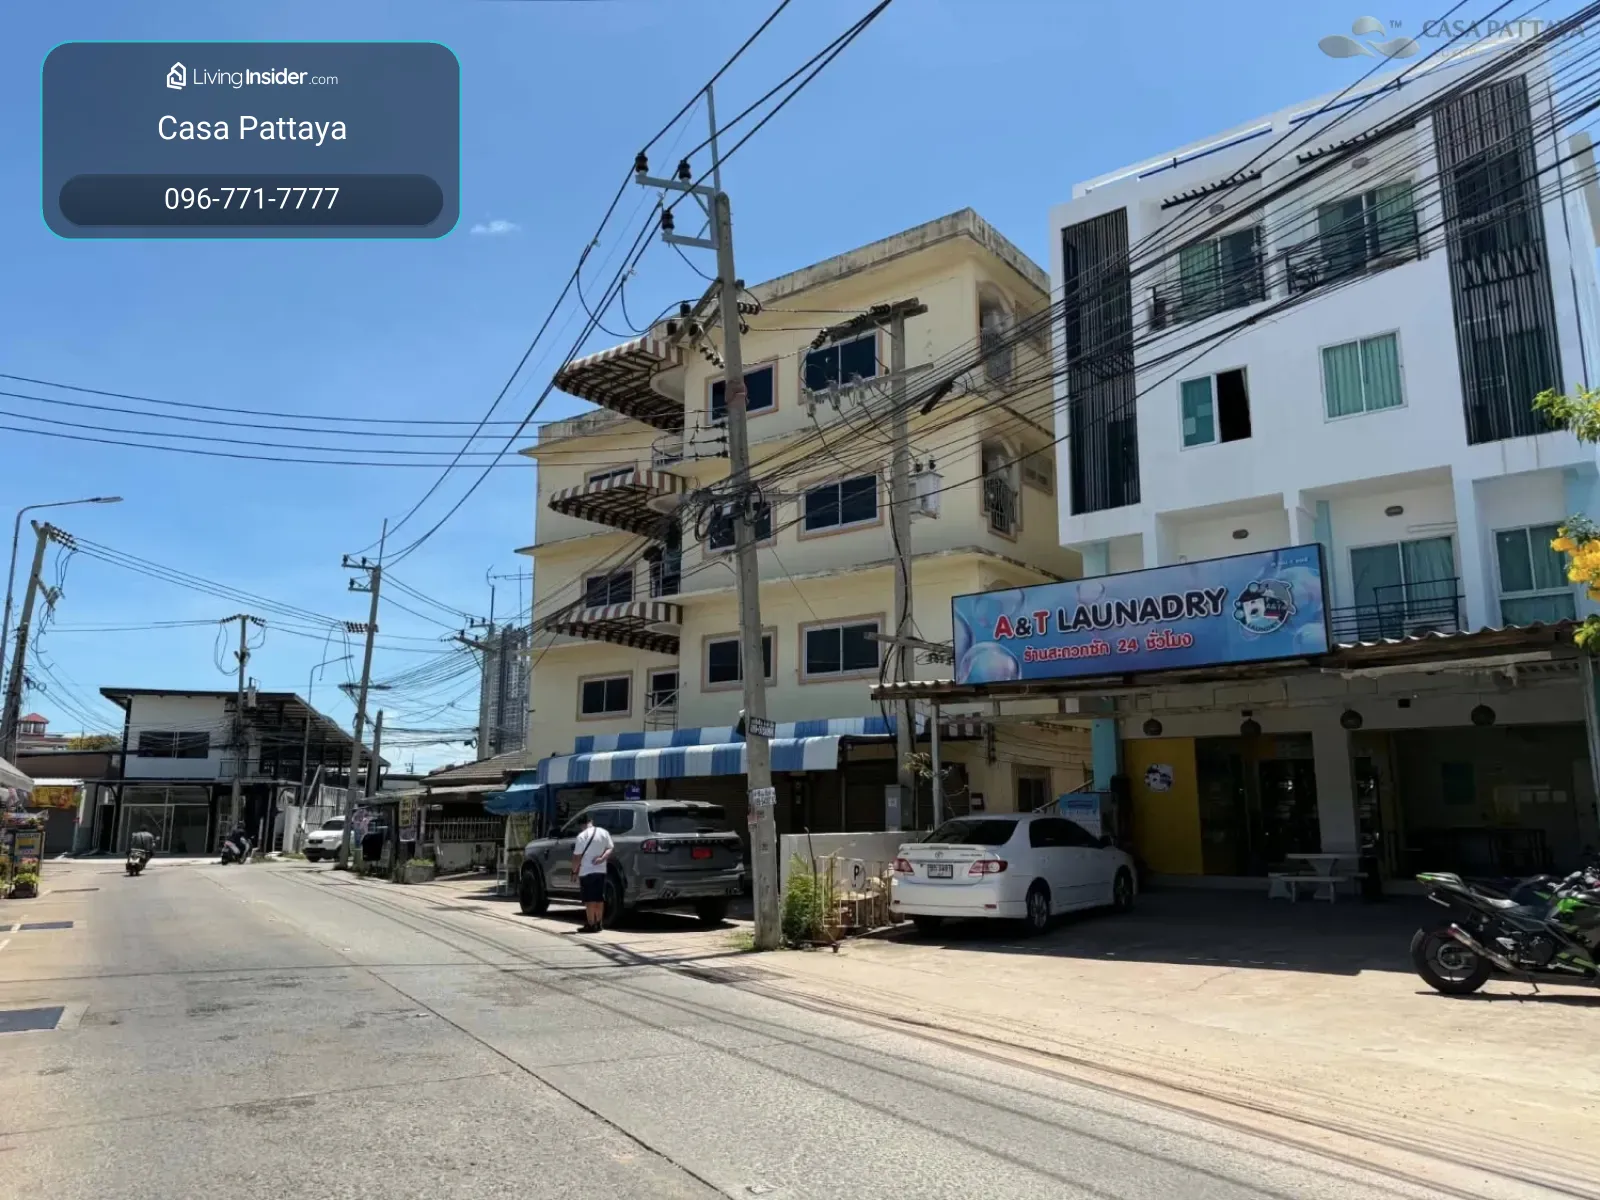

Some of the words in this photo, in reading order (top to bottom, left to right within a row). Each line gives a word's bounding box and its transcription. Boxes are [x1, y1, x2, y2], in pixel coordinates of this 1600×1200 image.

[993, 609, 1050, 639] A&T
[1056, 586, 1227, 632] LAUNADRY
[1024, 639, 1111, 663] ร้านสะดวกซัก
[1117, 637, 1139, 654] 24
[1145, 628, 1194, 651] ชั่วโมง
